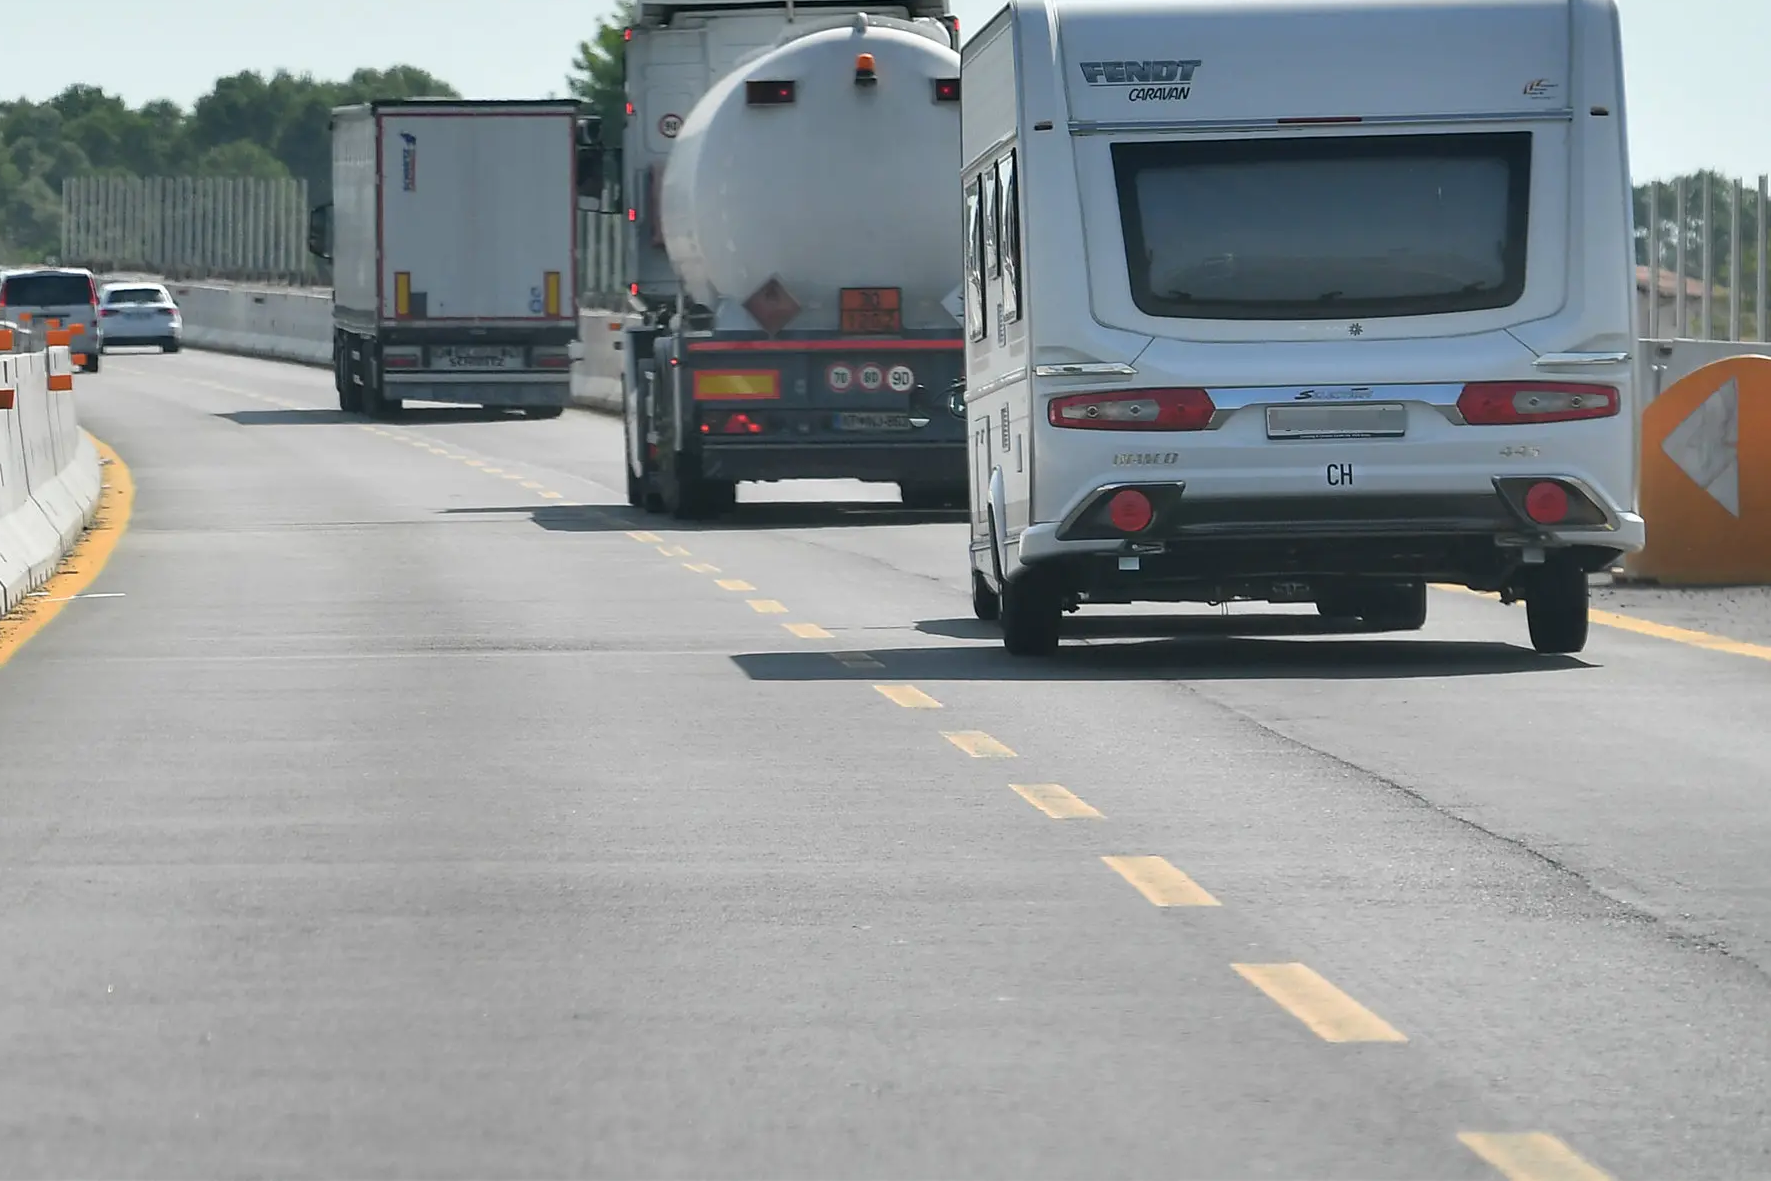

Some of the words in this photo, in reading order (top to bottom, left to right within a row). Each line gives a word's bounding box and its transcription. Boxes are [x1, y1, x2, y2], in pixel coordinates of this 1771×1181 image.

[1079, 59, 1202, 83] FENDT
[1128, 86, 1191, 102] CARAVAN
[833, 371, 848, 384] 70
[892, 371, 910, 385] 90
[1326, 463, 1353, 486] CH
